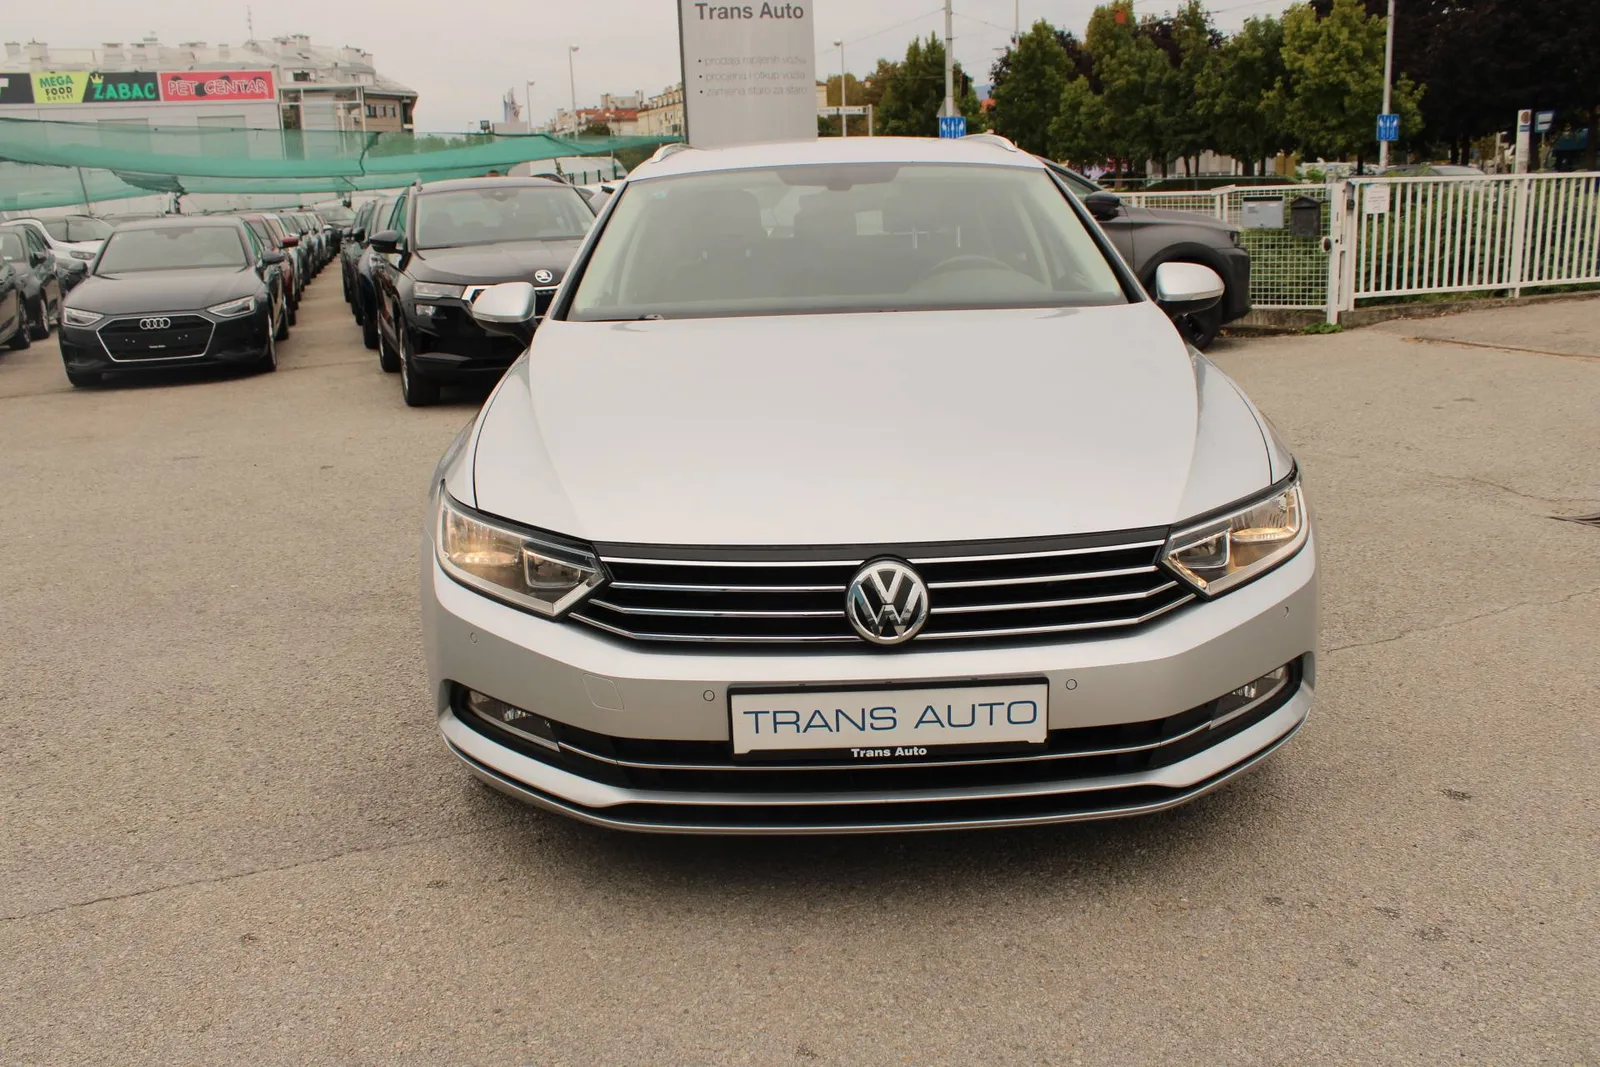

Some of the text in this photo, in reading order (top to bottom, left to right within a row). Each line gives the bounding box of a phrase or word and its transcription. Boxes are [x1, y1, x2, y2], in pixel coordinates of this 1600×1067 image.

[695, 2, 804, 20] Trans Auto
[39, 75, 74, 88] MEGA
[167, 78, 269, 96] PET CENTAR
[45, 86, 72, 96] FOOD
[743, 700, 1038, 734] TRANS AUTO
[851, 746, 927, 758] Trans Auto
